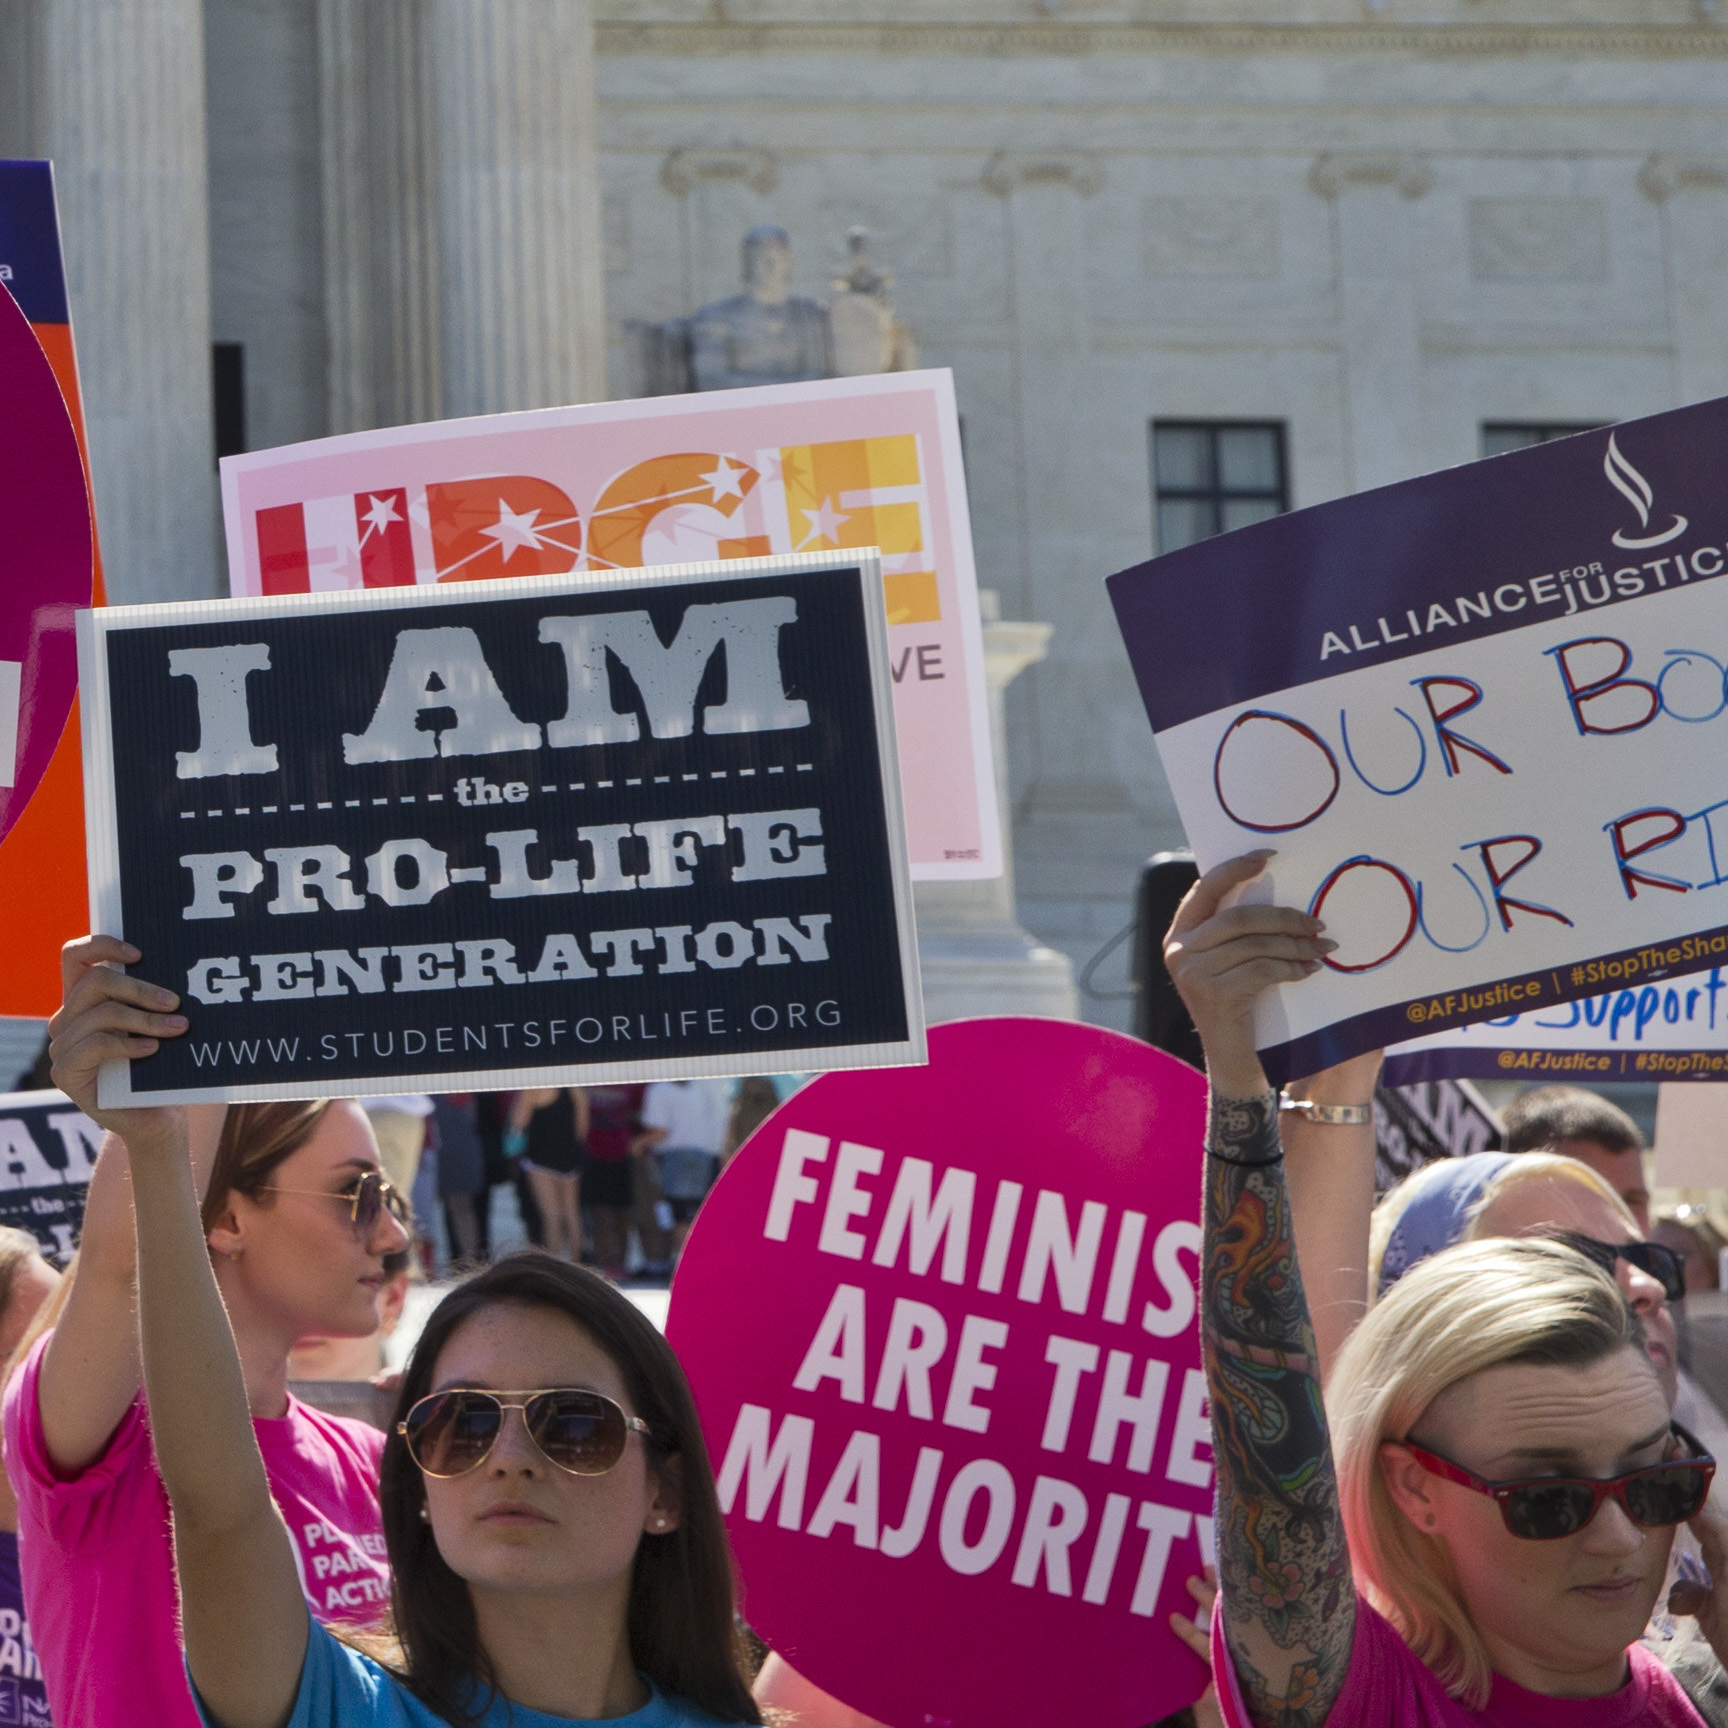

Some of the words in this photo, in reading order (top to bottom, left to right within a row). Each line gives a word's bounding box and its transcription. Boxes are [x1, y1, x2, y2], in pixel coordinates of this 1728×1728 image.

[1319, 573, 1562, 661] ALLIANCE
[1558, 561, 1604, 583] FOR
[1563, 542, 1728, 616] JUSTIC
[168, 641, 279, 780] I
[341, 595, 811, 766] AM
[1214, 676, 1513, 833] OUR
[1542, 637, 1728, 735] BO
[454, 776, 530, 807] the
[179, 807, 828, 920] PRO-LIFE
[1307, 835, 1574, 973] OUR
[186, 913, 832, 1007] GENERATION
[1406, 980, 1542, 1023] @AFJustice
[1570, 932, 1728, 987] #StopTheSha
[190, 999, 843, 1068] WWW.STUDENTSFORLIFE.ORG
[1497, 1050, 1611, 1070] @AFJustice
[30, 1196, 65, 1215] the
[763, 1127, 1205, 1339] FEMINIS
[792, 1283, 1009, 1434] ARE
[1039, 1334, 1215, 1489] THE
